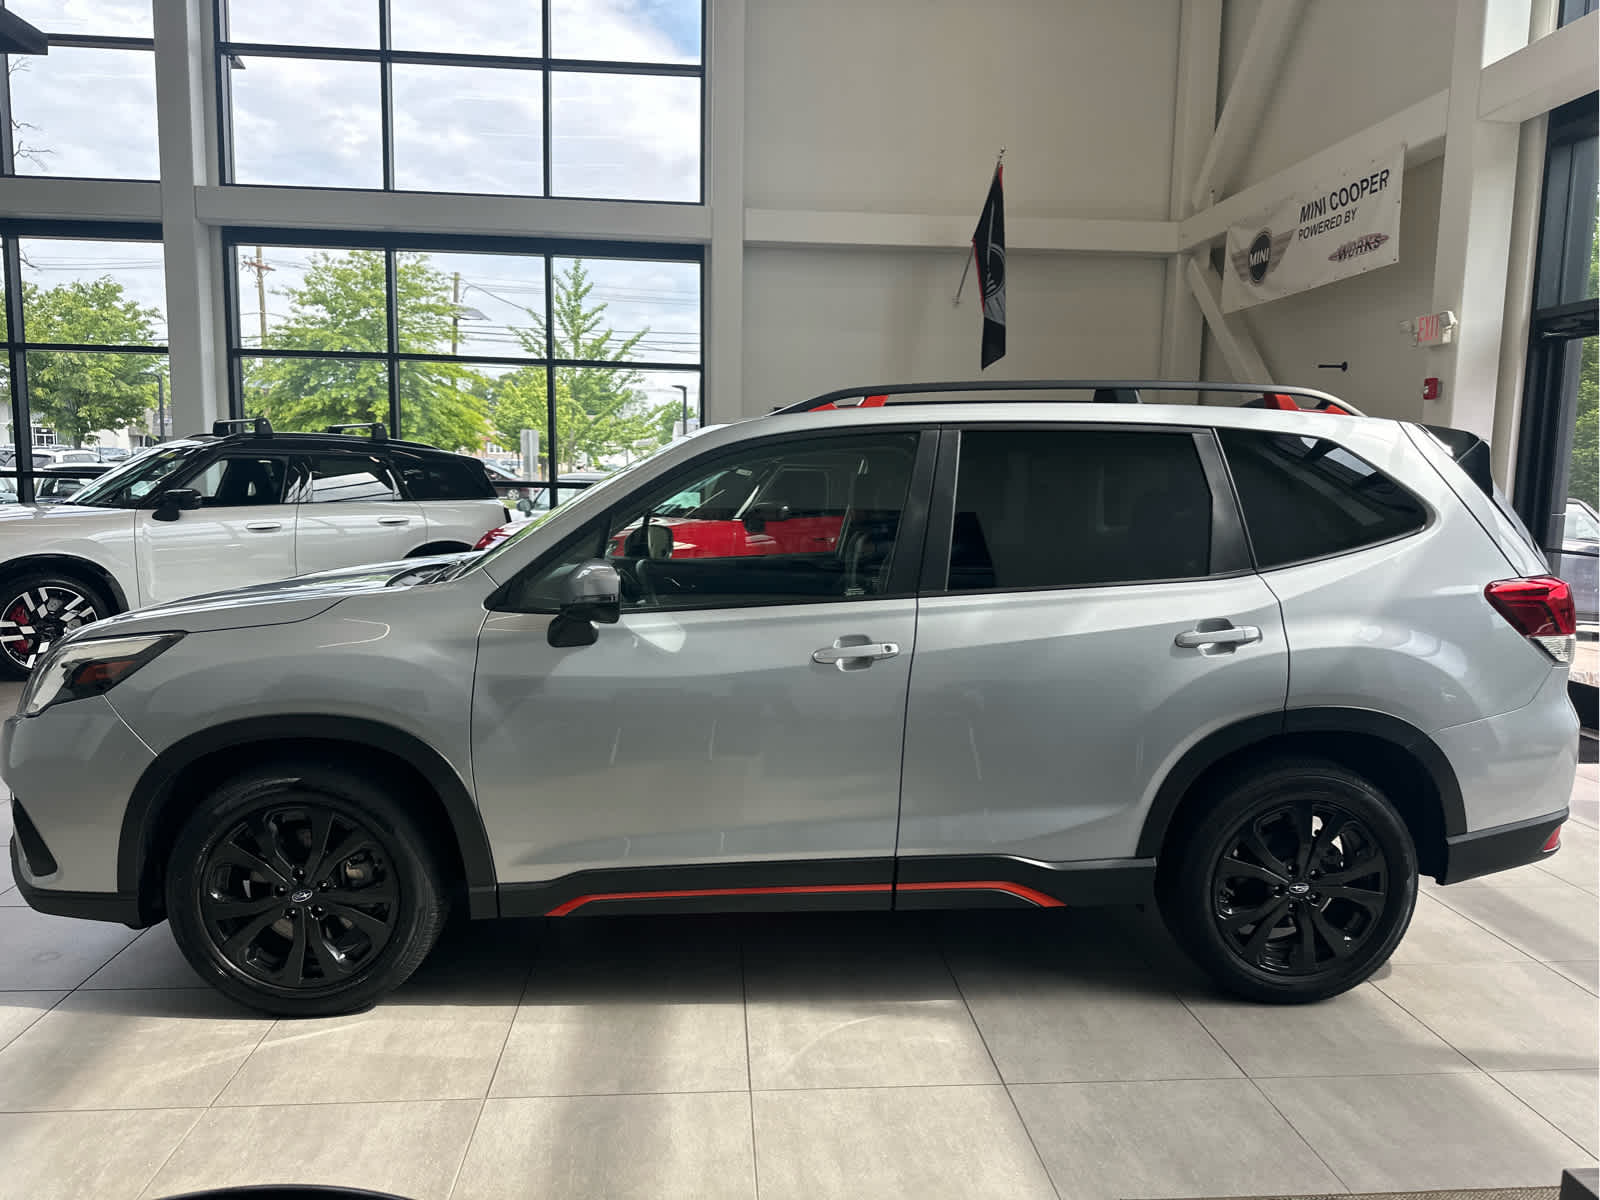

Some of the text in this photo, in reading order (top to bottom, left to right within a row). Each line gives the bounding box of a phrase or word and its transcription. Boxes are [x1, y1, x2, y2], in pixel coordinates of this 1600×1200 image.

[1299, 168, 1390, 224] MINI COOPER
[1298, 207, 1358, 240] POWERED BY
[1249, 247, 1270, 267] MINI
